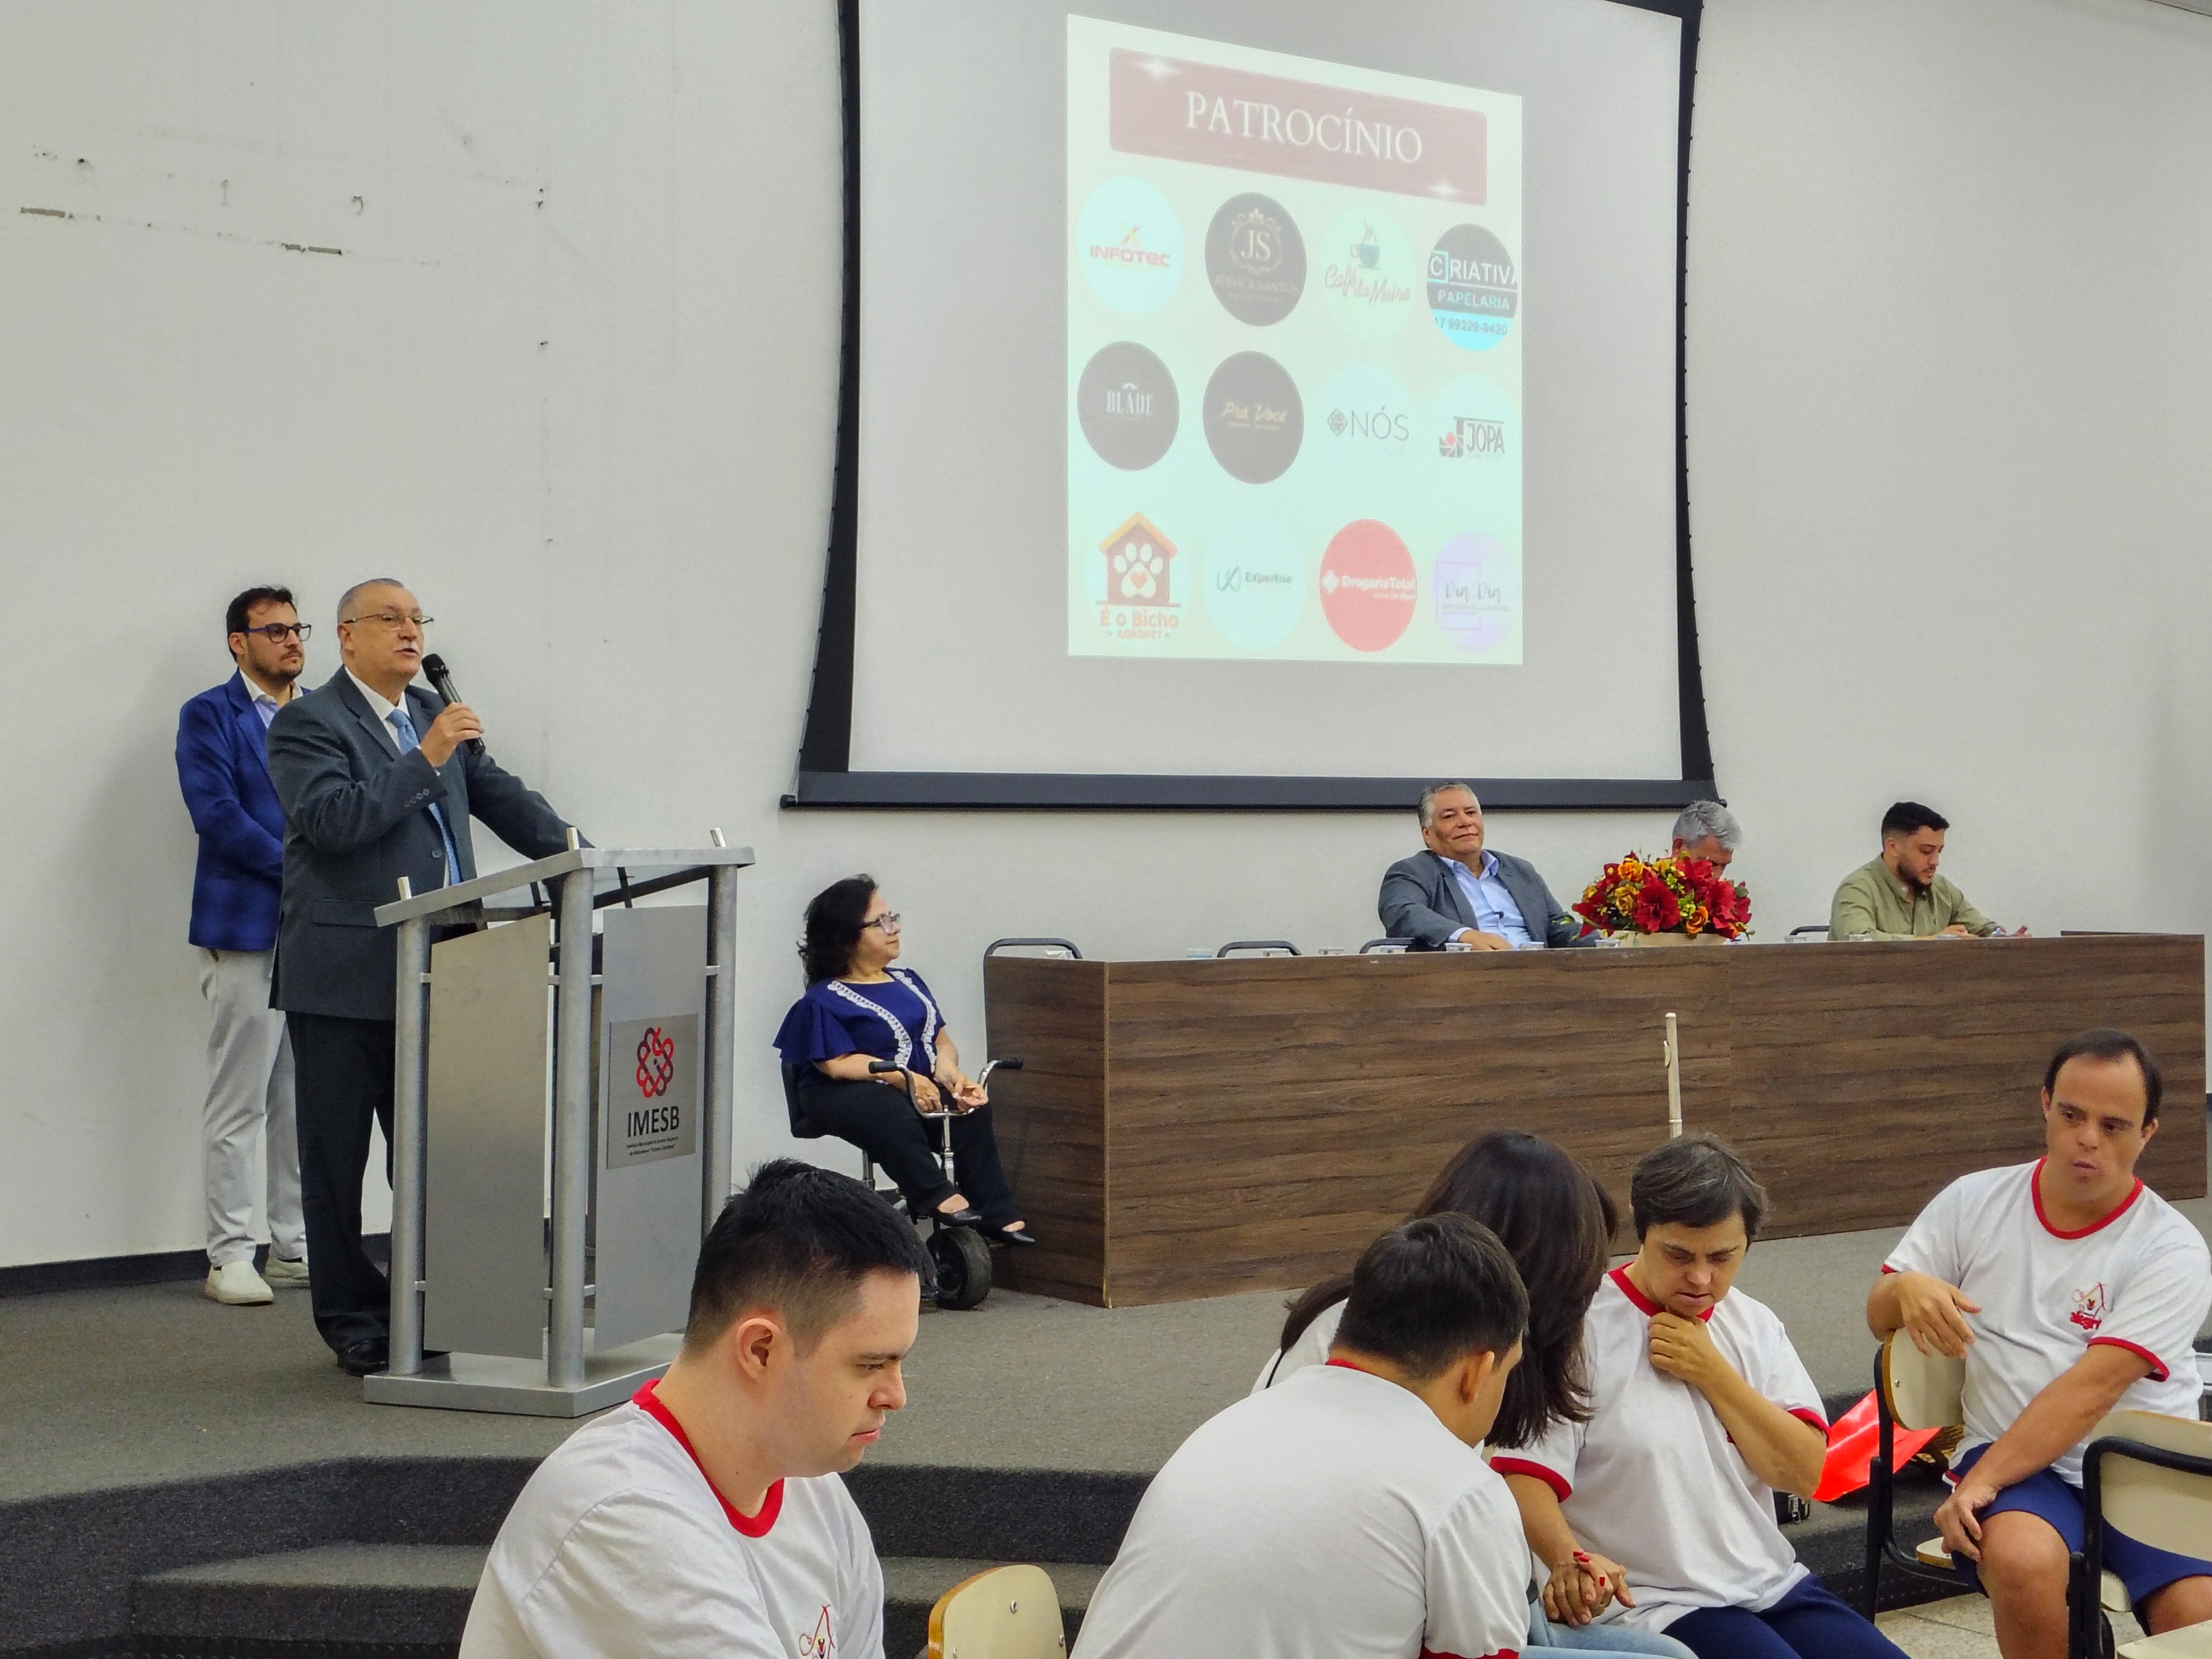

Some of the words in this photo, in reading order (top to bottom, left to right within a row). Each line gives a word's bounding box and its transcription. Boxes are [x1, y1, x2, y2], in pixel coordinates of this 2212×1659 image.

[1185, 91, 1422, 163] PATROCÍNIO
[1241, 230, 1271, 261] JS
[1325, 264, 1357, 298] Café
[1438, 289, 1510, 311] PAPELARIA
[1351, 406, 1410, 441] NÓS
[1466, 423, 1505, 454] JOPA
[1245, 571, 1293, 584] Expertise
[1100, 606, 1111, 626] É
[1116, 612, 1127, 626] o
[1132, 608, 1179, 629] Bicho
[628, 1106, 680, 1137] IMESB
